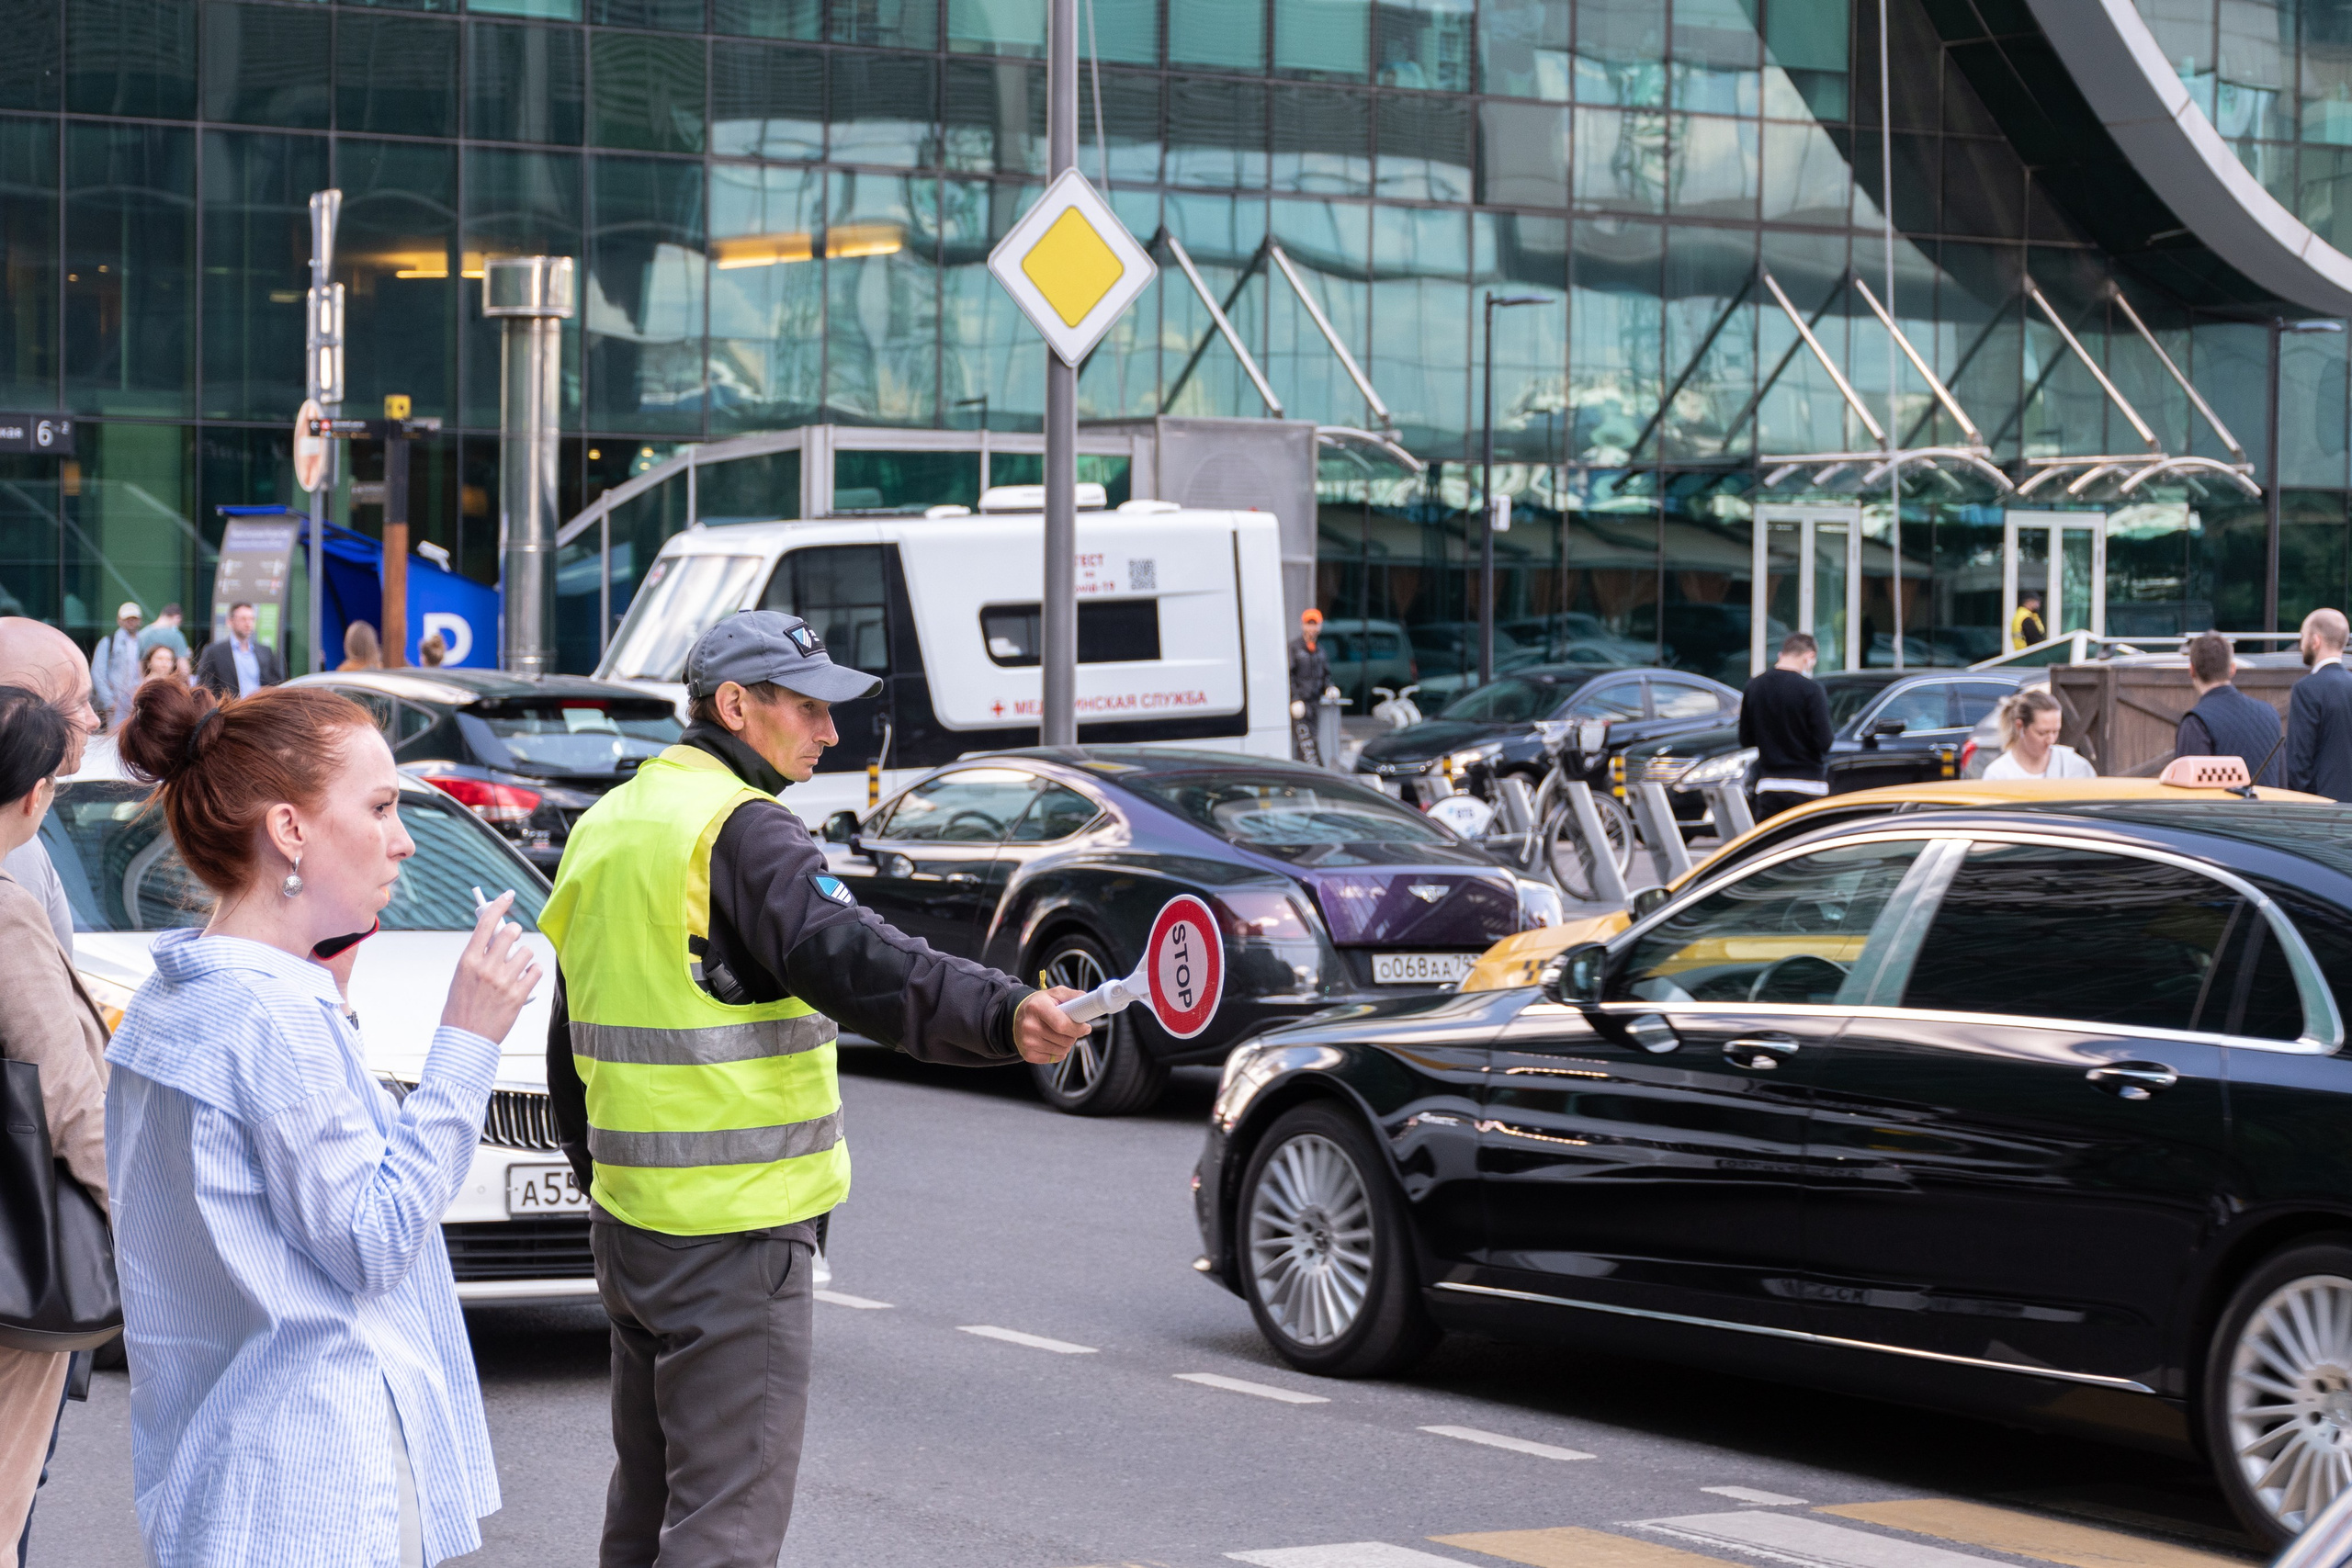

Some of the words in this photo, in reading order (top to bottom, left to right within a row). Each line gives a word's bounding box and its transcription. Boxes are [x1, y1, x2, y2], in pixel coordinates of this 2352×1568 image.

[1013, 694, 1137, 716] МЕДИНСКАЯ
[1140, 690, 1207, 708] СЛУЖБА
[1171, 923, 1193, 1009] STOP
